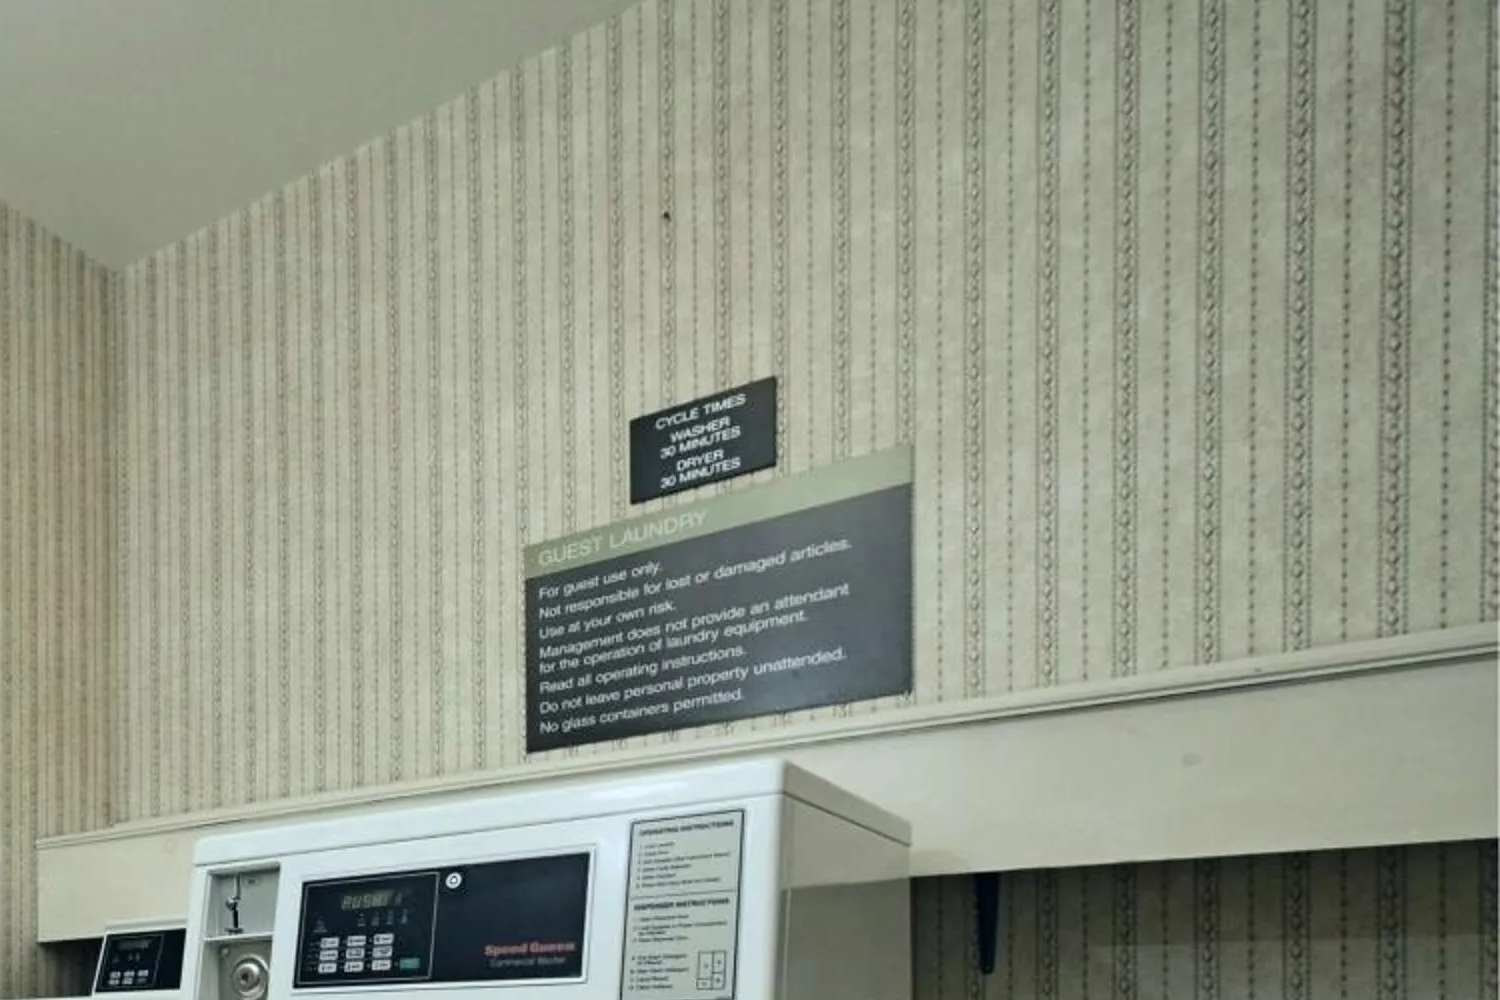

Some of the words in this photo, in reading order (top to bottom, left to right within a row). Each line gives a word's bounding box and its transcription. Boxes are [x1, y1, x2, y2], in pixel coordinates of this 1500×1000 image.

[655, 407, 700, 430] CYCLE
[703, 393, 747, 415] TIMES
[670, 415, 731, 443] WASHER
[660, 445, 676, 459] 30
[680, 425, 741, 453] MINUTES
[676, 449, 724, 472] DRYER
[660, 475, 676, 489] 30
[679, 456, 741, 483] MINUTES
[538, 535, 603, 566] GUEST
[609, 509, 707, 549] LAUNDRY
[539, 604, 562, 619] Not
[564, 587, 640, 614] responsible
[643, 582, 663, 596] for
[665, 575, 692, 591] lost
[695, 571, 711, 584] or
[713, 550, 787, 580] damaged
[790, 538, 852, 563] articles.
[539, 585, 560, 600] For
[563, 575, 599, 597] guest
[603, 570, 627, 585] use
[539, 624, 565, 640] Use
[567, 621, 581, 633] at
[583, 614, 613, 632] your
[615, 607, 645, 623] own
[649, 600, 677, 615] risk.
[539, 631, 624, 660] Management
[627, 625, 661, 641] does
[665, 618, 689, 633] not
[691, 606, 746, 630] provide
[750, 602, 770, 616] an
[773, 582, 850, 611] attendant
[539, 660, 557, 675] for
[559, 658, 580, 671] the
[583, 643, 645, 667] operation
[650, 637, 663, 651] of
[666, 627, 719, 649] laundry
[723, 609, 809, 638] equipment.
[539, 677, 574, 695] Read
[577, 673, 593, 687] all
[595, 662, 660, 685] operating
[662, 645, 748, 672] instructions.
[539, 700, 559, 715] Do
[561, 697, 584, 711] not
[585, 690, 621, 706] leave
[623, 676, 684, 700] personal
[687, 665, 749, 690] property
[753, 645, 848, 676] unattended.
[539, 720, 559, 735] No
[561, 714, 597, 733] glass
[600, 702, 670, 724] containers
[673, 688, 745, 714] permitted.
[484, 942, 527, 957] Speed
[529, 940, 575, 954] Queen
